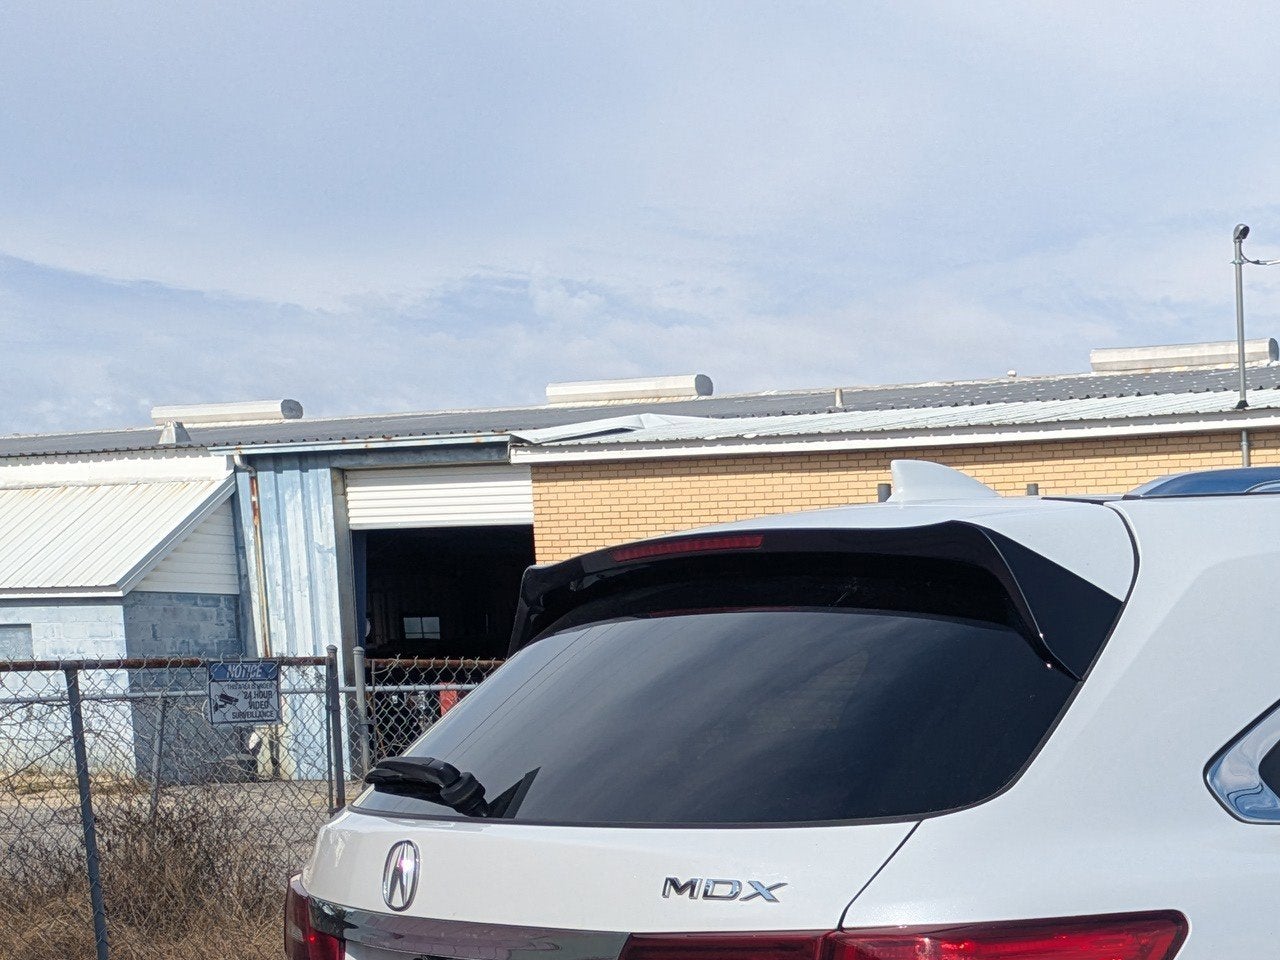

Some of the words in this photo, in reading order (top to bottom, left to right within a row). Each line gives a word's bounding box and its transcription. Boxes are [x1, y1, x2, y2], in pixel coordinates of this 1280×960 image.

[226, 664, 262, 678] NOTICE
[243, 691, 252, 699] 24
[254, 690, 273, 699] HOUR
[249, 700, 269, 709] VIDEO
[232, 710, 275, 719] SURVEILLANCE
[661, 876, 789, 903] MDX
